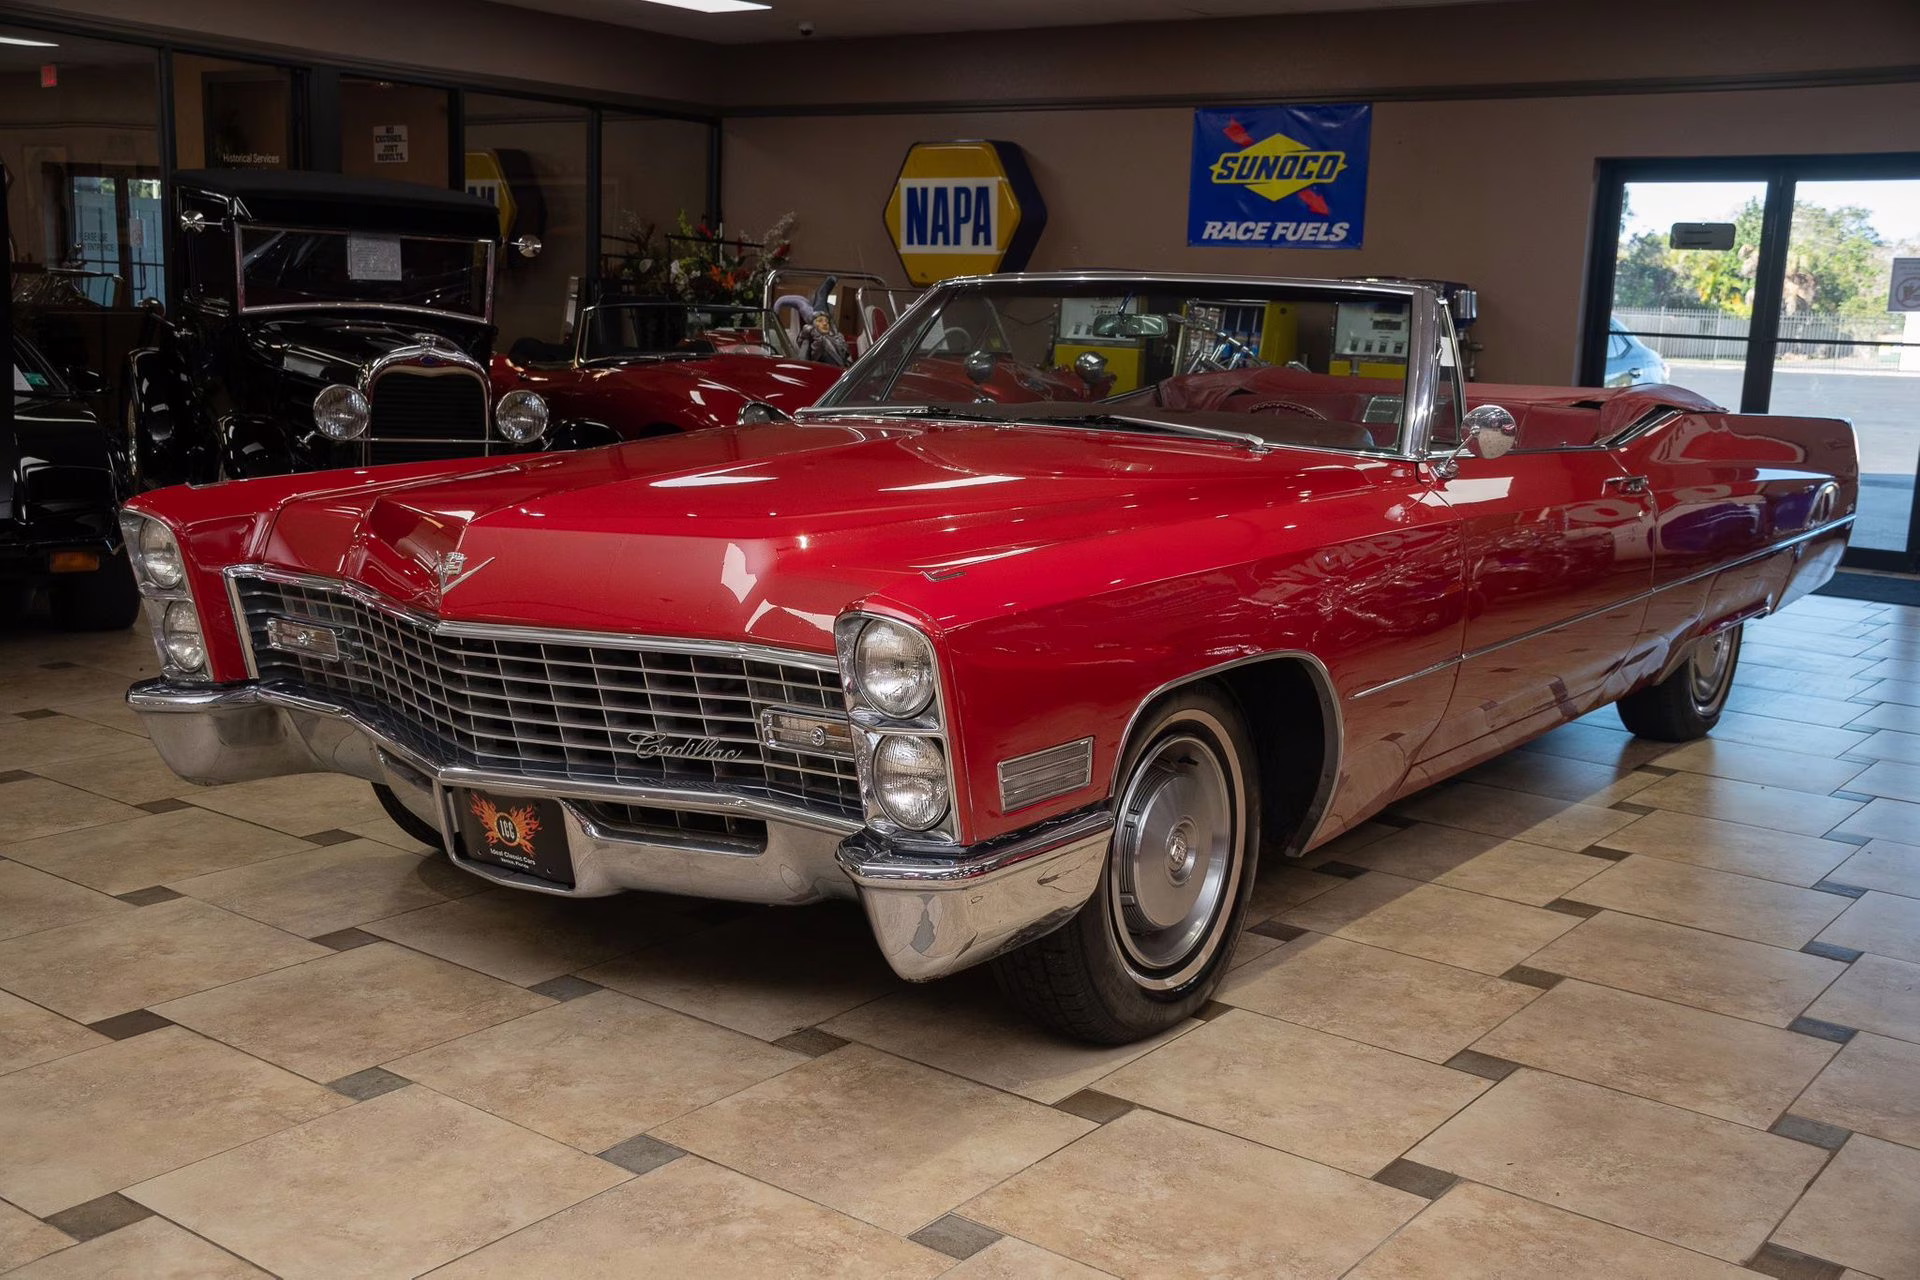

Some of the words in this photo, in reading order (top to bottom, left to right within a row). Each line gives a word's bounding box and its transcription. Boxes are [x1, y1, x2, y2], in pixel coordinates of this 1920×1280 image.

[223, 153, 252, 163] Historical
[253, 153, 280, 163] Services
[1216, 155, 1341, 180] SUNOCO
[907, 186, 992, 246] NAPA
[1202, 221, 1272, 241] RACE
[1271, 221, 1350, 241] FUELS
[627, 732, 743, 761] Cadillac
[499, 819, 515, 839] ICC
[490, 848, 503, 856] Ideal
[504, 851, 522, 861] Classic
[523, 857, 536, 865] Cars
